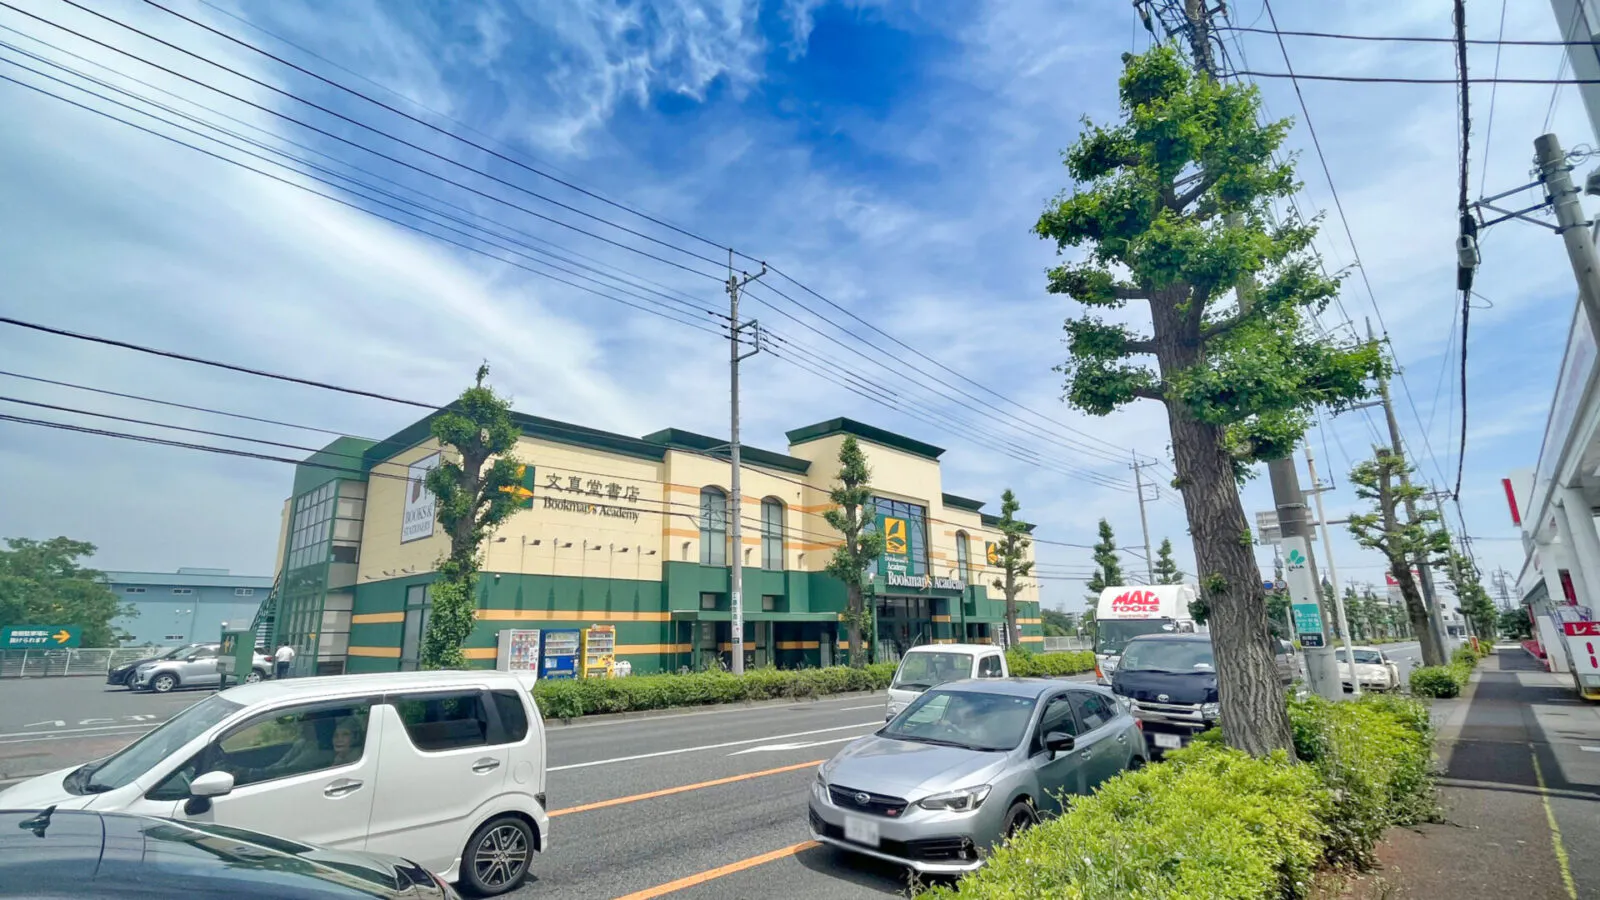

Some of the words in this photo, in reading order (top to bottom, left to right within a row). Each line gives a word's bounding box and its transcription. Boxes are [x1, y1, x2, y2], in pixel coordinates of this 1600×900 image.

[544, 472, 640, 503] 文真堂書店
[599, 504, 640, 524] Academy
[934, 576, 966, 594] Academy
[1113, 591, 1159, 605] MAC
